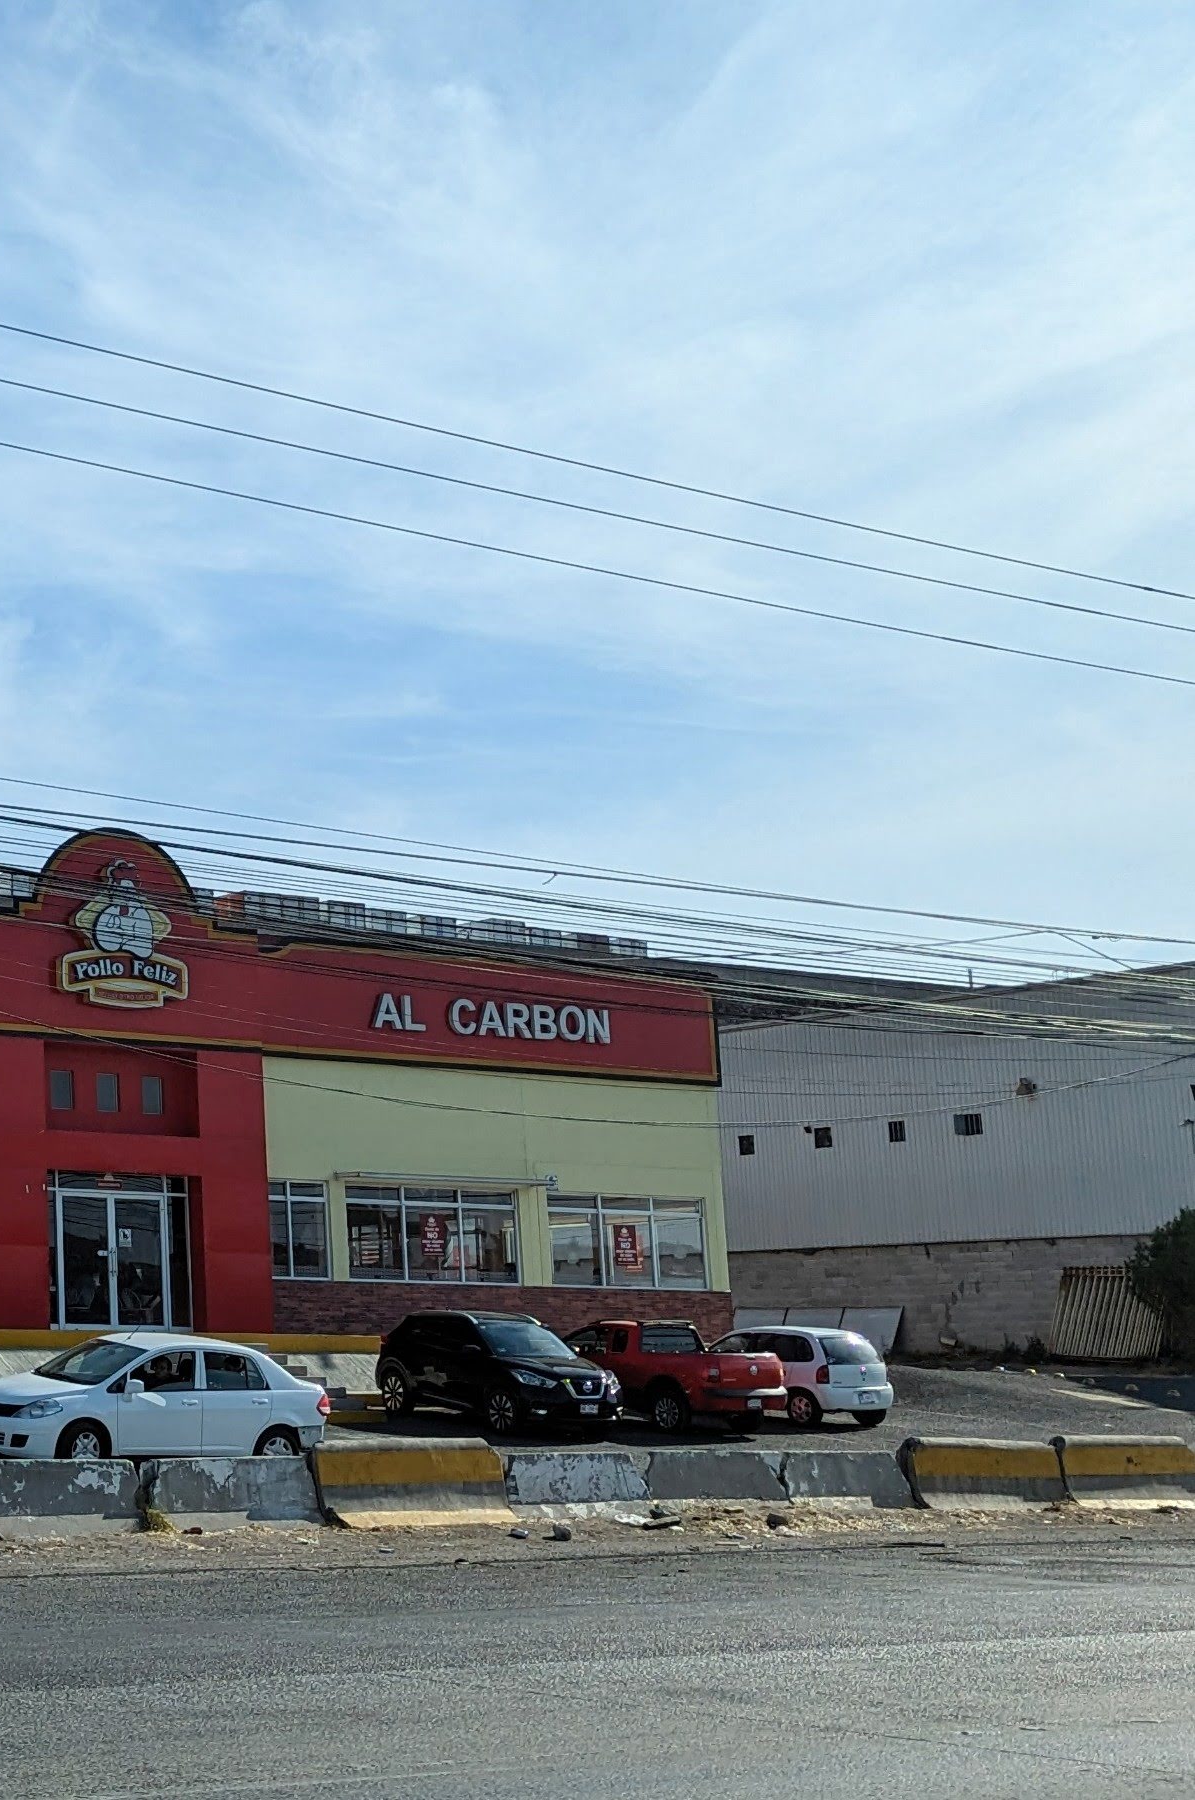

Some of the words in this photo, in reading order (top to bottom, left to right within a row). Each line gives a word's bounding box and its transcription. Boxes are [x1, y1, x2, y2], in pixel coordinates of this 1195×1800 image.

[74, 959, 124, 980] Pollo
[132, 959, 178, 986] Feliz
[373, 993, 426, 1032] AL
[449, 998, 611, 1044] CARBON
